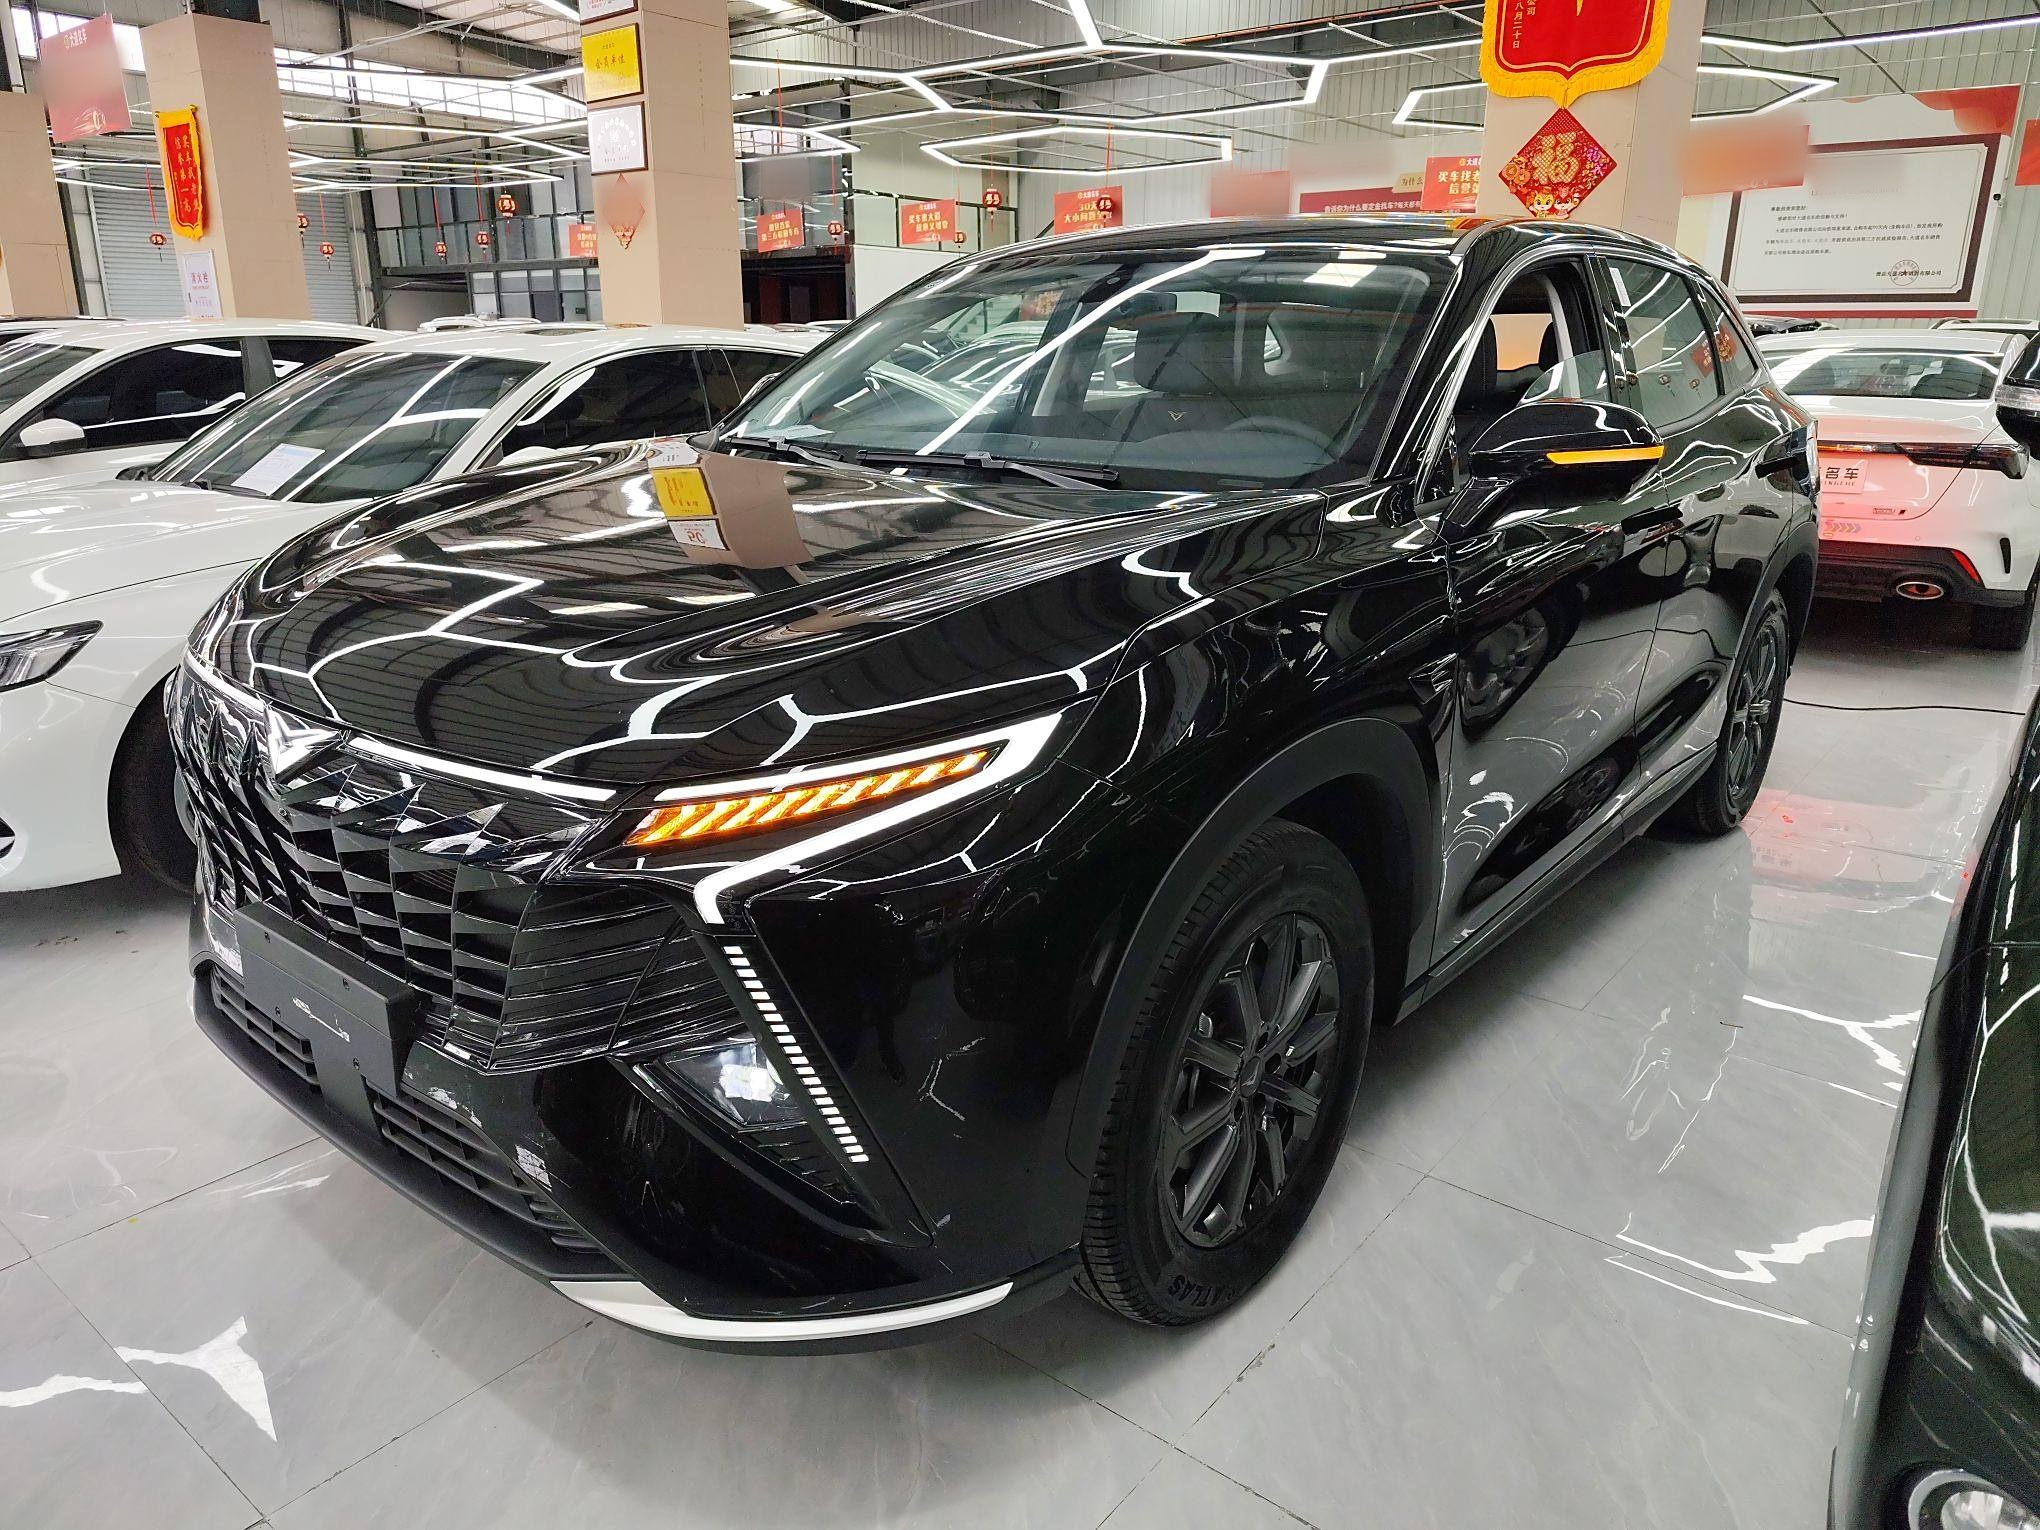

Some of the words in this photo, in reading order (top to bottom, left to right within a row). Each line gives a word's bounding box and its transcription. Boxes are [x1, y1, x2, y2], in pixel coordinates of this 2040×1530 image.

[1512, 1, 1524, 49] 八月二十日
